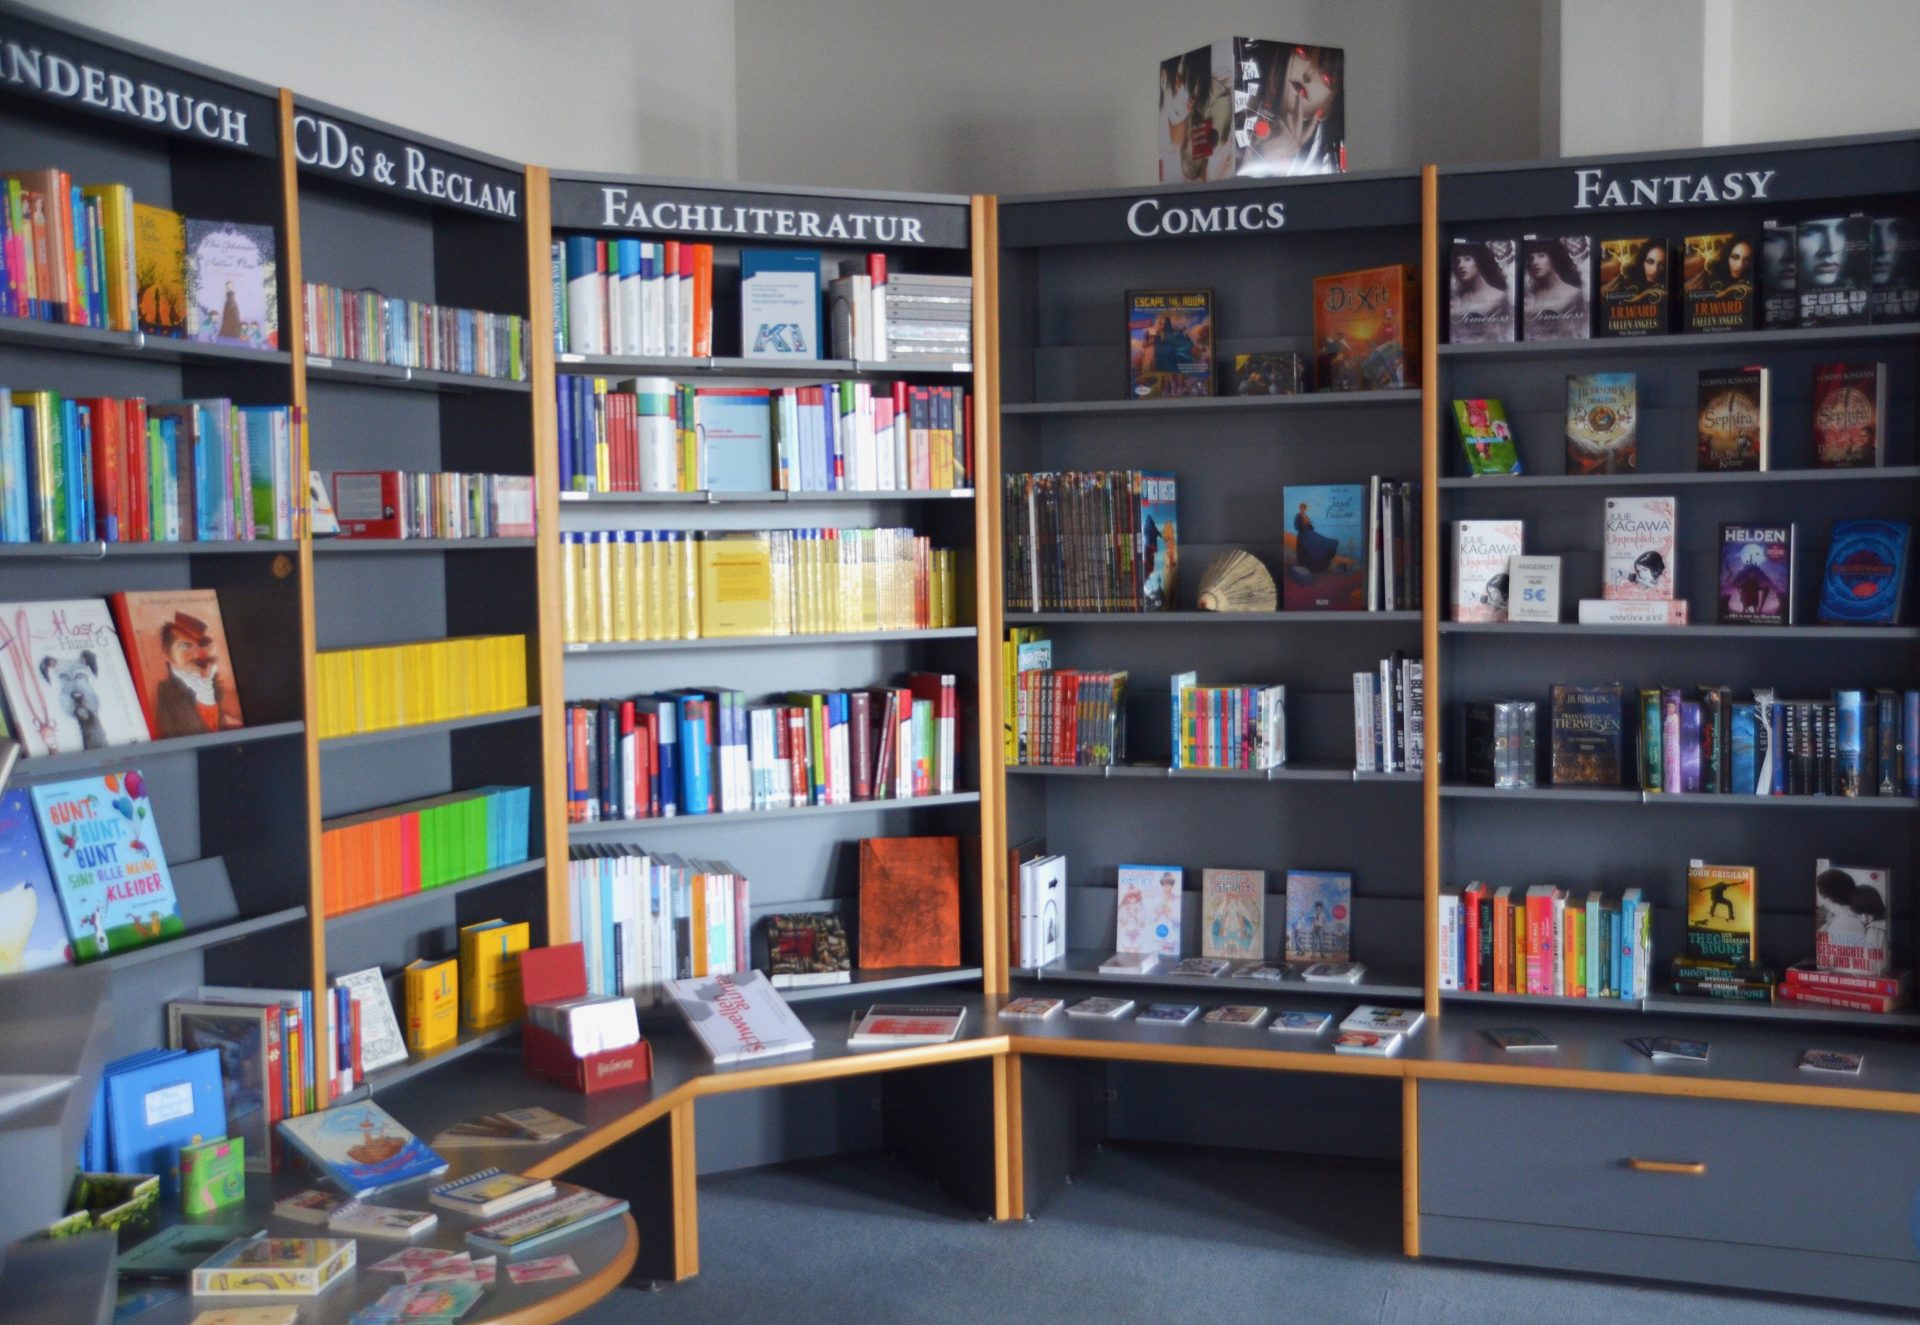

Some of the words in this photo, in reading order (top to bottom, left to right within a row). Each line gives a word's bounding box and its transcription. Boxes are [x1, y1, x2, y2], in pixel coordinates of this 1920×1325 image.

[373, 153, 396, 186] &
[405, 147, 517, 217] RECLAM
[1573, 168, 1776, 210] FANTASY
[601, 187, 925, 243] FACHLITERATUR
[1126, 198, 1286, 238] COMICS
[1135, 296, 1165, 307] ESCAPE
[1801, 290, 1867, 306] COLD
[1453, 309, 1510, 324] Timeless
[1525, 308, 1584, 322] Timeless
[1609, 319, 1632, 330] FALLEN
[752, 323, 808, 353] KI
[1704, 411, 1753, 432] Sephira
[1610, 512, 1632, 521] JULIE
[1606, 520, 1670, 532] KAGAWA
[1724, 530, 1786, 543] HELDEN
[1460, 543, 1519, 555] KAGAWA
[1518, 563, 1554, 571] ANGEBOT
[1522, 588, 1546, 602] 5€
[1553, 718, 1621, 730] TIERWESEN
[1786, 706, 1794, 753] TRANSPORT
[76, 842, 118, 869] BUNT
[1688, 869, 1710, 877] JOHN
[1712, 870, 1750, 879] GRISHAM
[106, 872, 165, 902] KLEIDER
[1688, 932, 1721, 944] THEO
[1701, 944, 1744, 954] BOONE
[1817, 943, 1864, 959] GESCHICHTE
